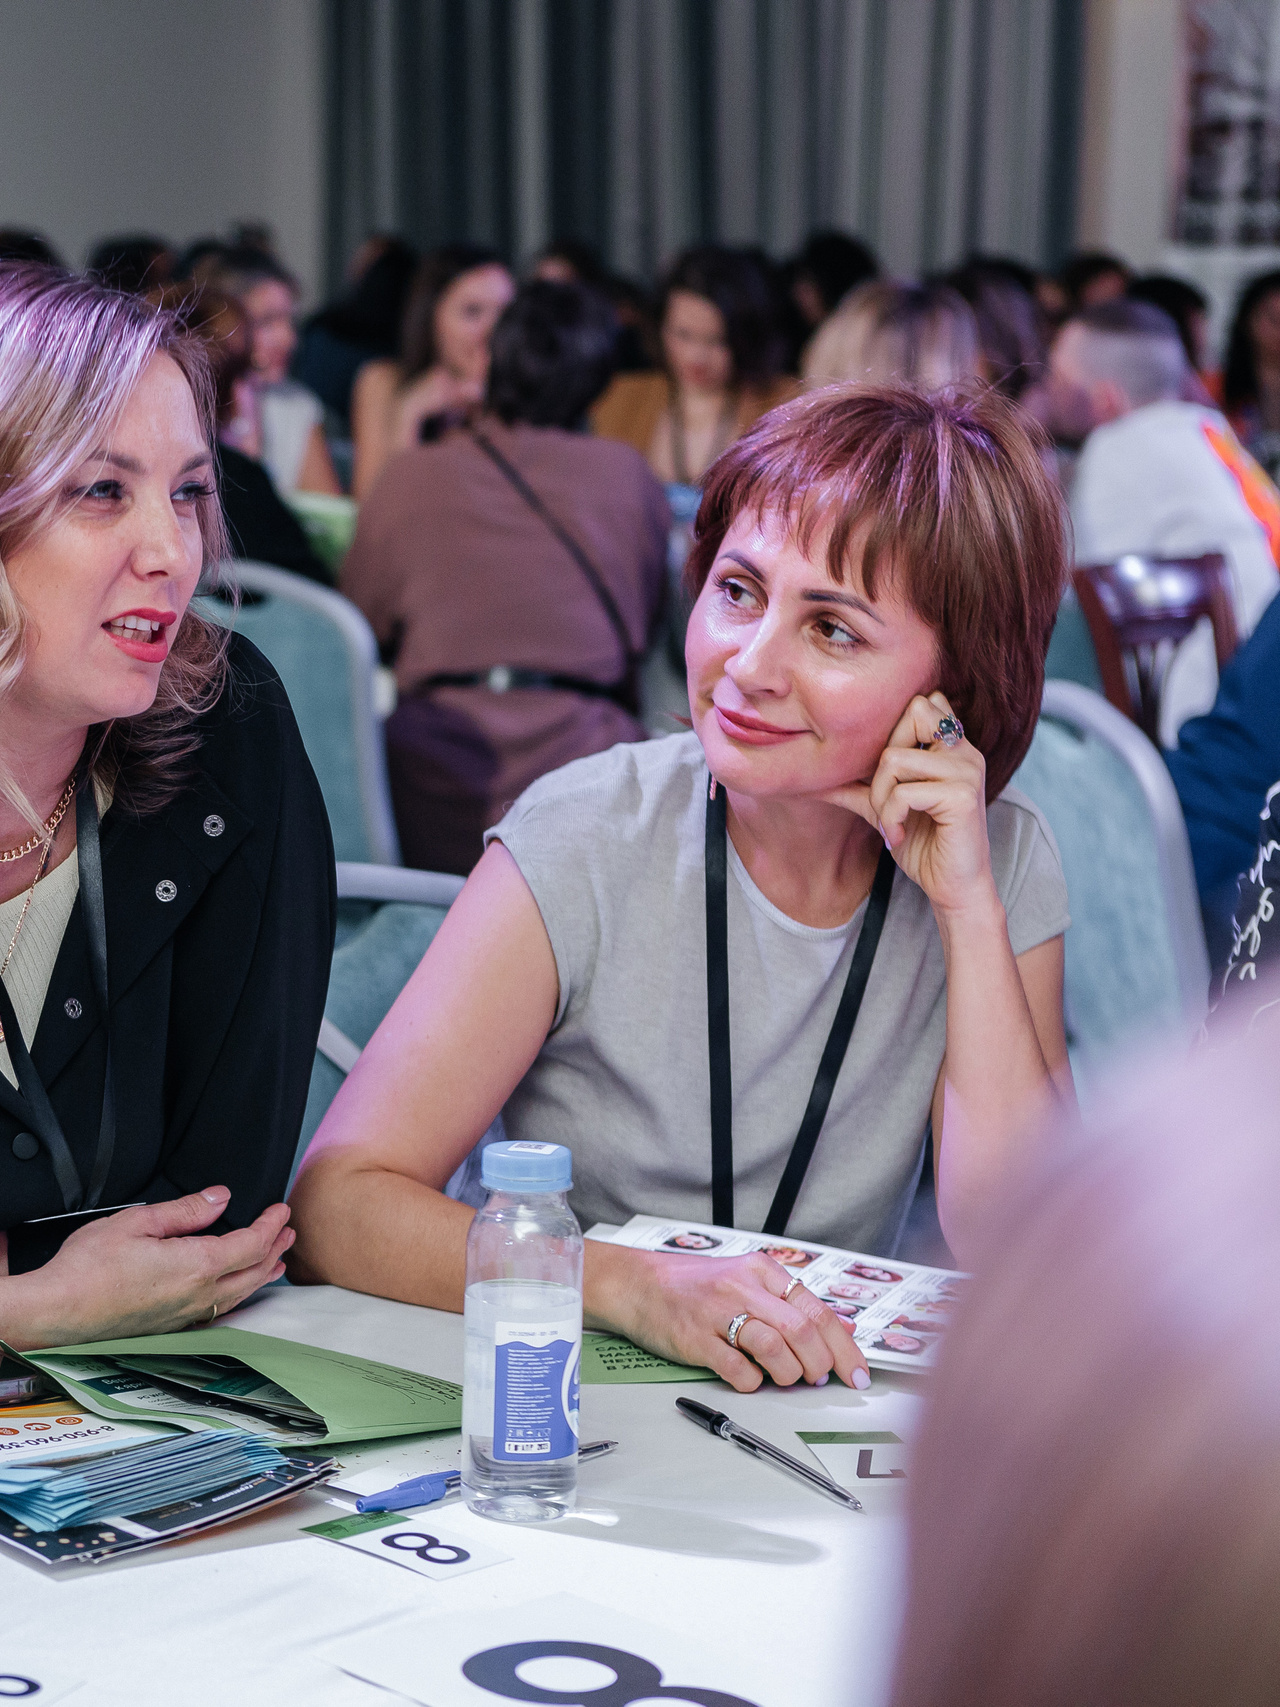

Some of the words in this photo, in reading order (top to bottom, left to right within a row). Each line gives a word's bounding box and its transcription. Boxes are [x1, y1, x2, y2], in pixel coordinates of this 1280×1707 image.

[602, 1355, 662, 1364] НЕТВО
[622, 1361, 678, 1370] ХАКАС
[856, 1449, 908, 1479] 7
[380, 1532, 471, 1565] 8
